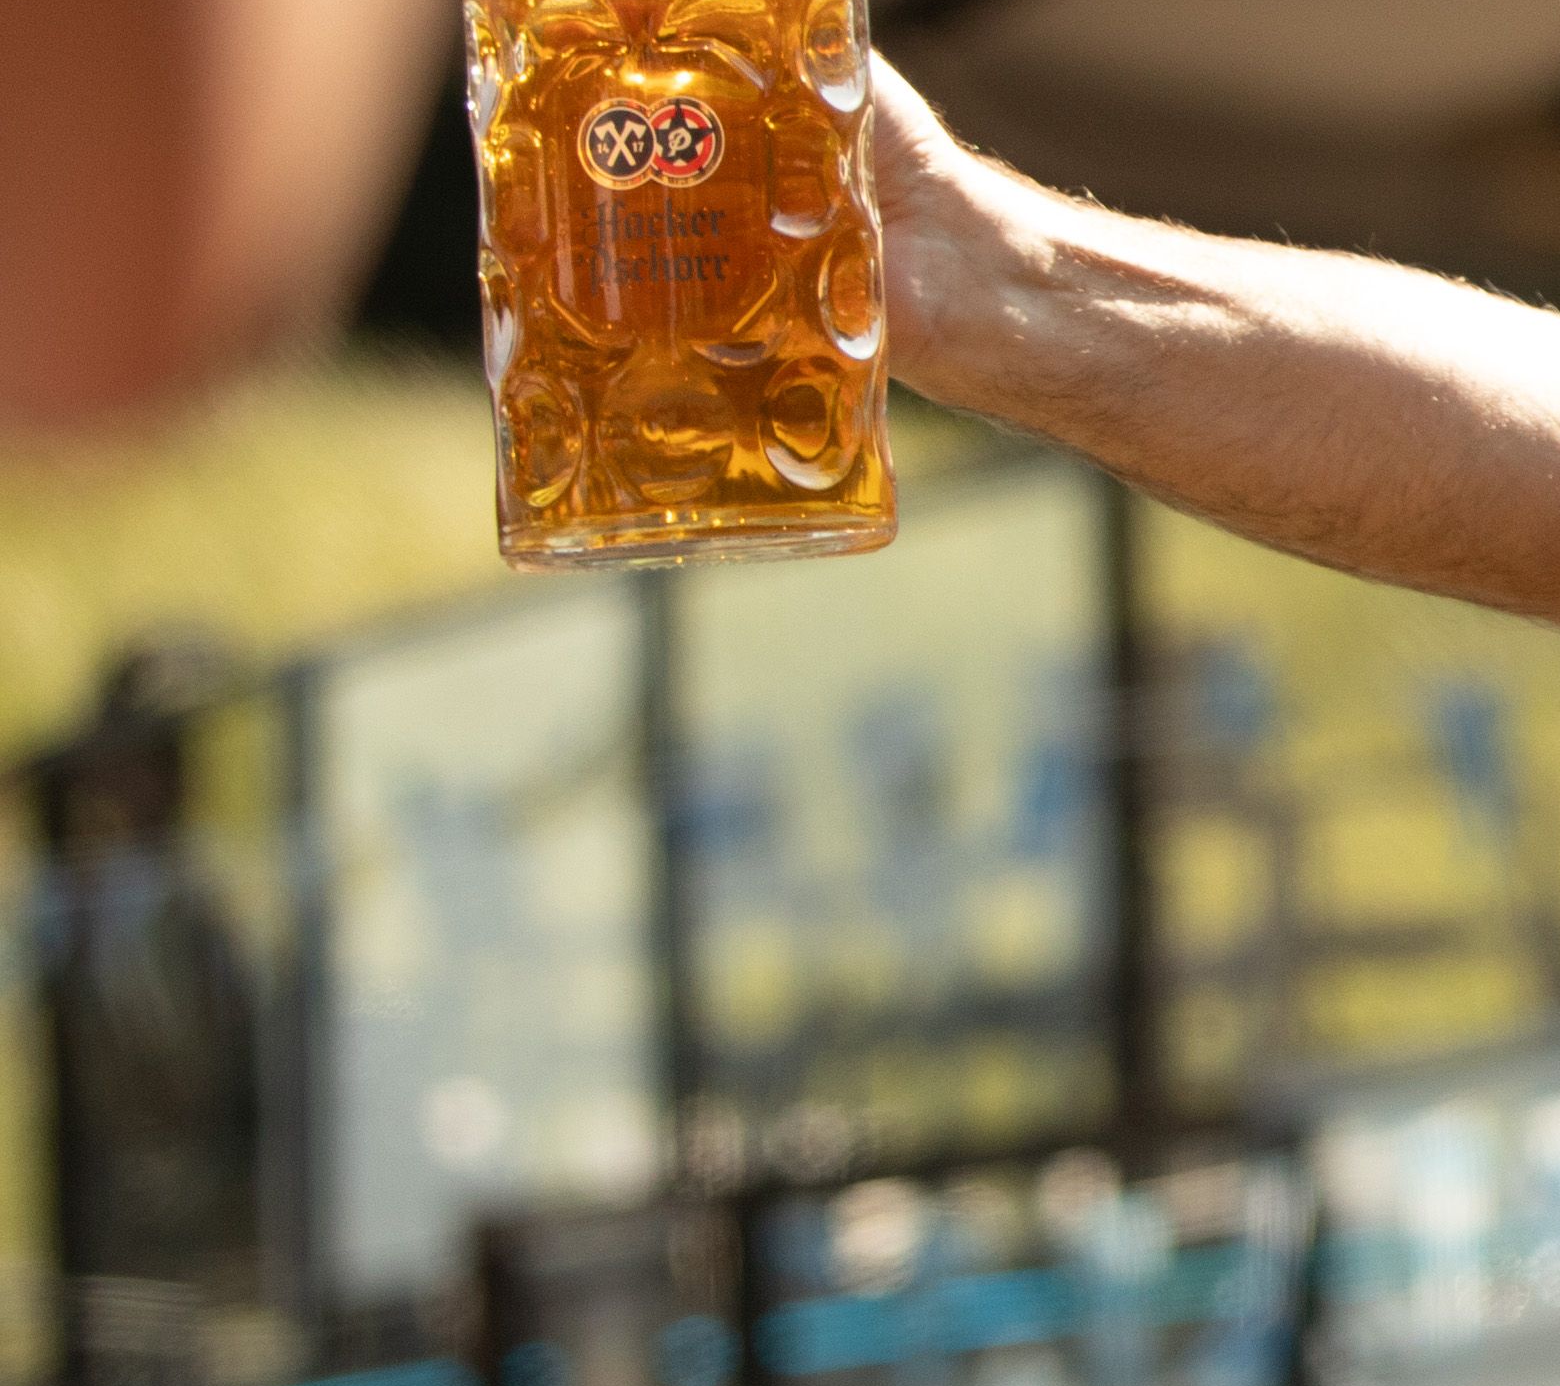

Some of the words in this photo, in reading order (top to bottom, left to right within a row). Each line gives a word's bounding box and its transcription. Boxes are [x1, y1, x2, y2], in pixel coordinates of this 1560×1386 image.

[632, 141, 645, 153] 17
[580, 197, 727, 249] Hacker
[576, 243, 731, 297] Pschorr
